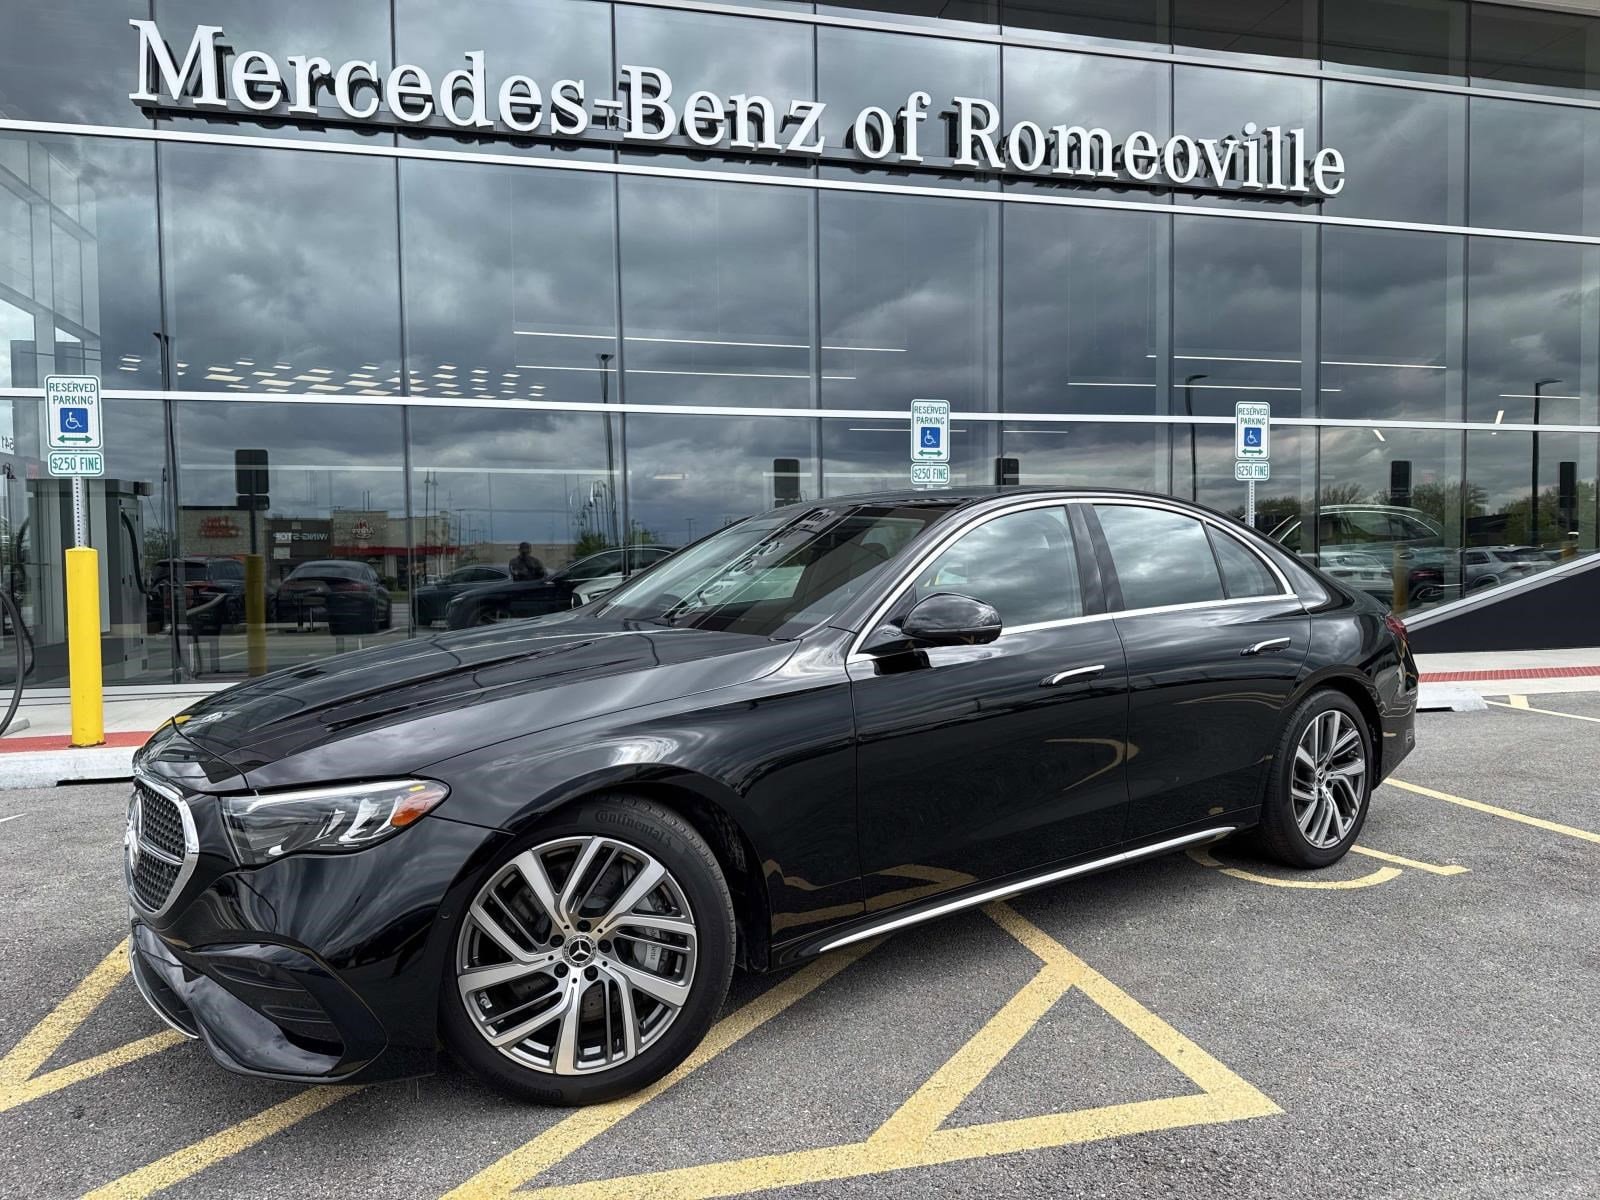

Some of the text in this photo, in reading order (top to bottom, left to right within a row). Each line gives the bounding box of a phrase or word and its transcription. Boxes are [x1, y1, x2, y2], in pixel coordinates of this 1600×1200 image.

[128, 18, 1347, 197] Mercedes-Benz of Romeoville
[49, 382, 96, 393] RESERVED
[52, 395, 94, 406] PARKING
[914, 406, 947, 415] RESERVED
[1238, 407, 1268, 416] RESERVED
[916, 416, 945, 425] PARKING
[1240, 417, 1266, 426] PARKING
[52, 457, 100, 471] $250 FINE
[913, 468, 947, 480] $250 FINE
[1238, 465, 1267, 477] $250 FINE
[594, 809, 666, 843] Continental
